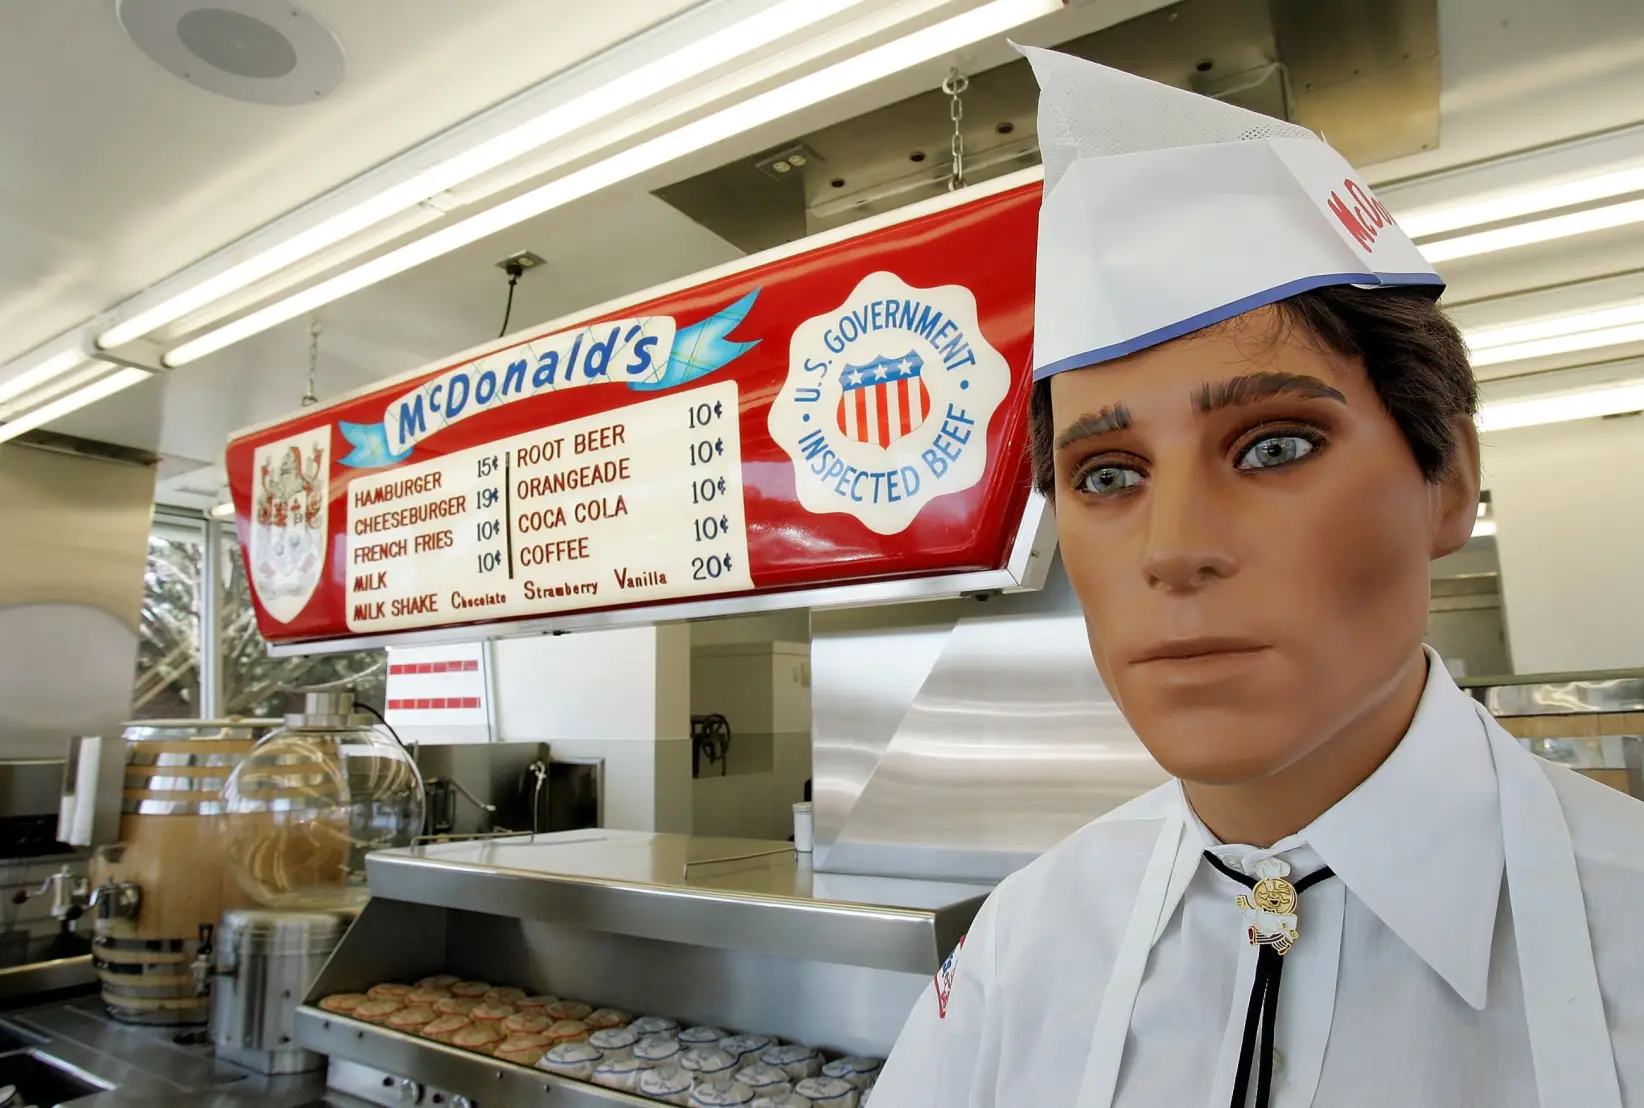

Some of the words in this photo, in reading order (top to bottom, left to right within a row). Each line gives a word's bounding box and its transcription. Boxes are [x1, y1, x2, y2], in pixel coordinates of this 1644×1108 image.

[1327, 178, 1398, 253] McDo
[794, 358, 832, 403] U.S.
[823, 299, 976, 372] GOVERNMENT
[399, 324, 659, 444] McDonald's
[517, 438, 565, 468] ROOT
[574, 424, 625, 455] BEER
[688, 400, 723, 428] 10¢
[798, 428, 921, 504] INSPECTED
[921, 402, 976, 480] BEEF
[355, 471, 442, 508] HAMBURGER
[477, 455, 499, 478] 15¢
[517, 457, 631, 500] ORANGEADE
[689, 437, 724, 466] 10¢
[354, 495, 466, 536] CHEESEBURGER
[476, 487, 499, 510] 19¢
[518, 506, 567, 533] COCA
[574, 494, 628, 523] COLA
[691, 476, 726, 504] 10¢
[353, 571, 387, 593] MILK
[477, 550, 501, 573] 10¢
[354, 538, 408, 565] FRENCH
[414, 529, 453, 554] FRIES
[476, 520, 500, 542] 10¢
[520, 537, 590, 567] COFFEE
[694, 514, 729, 542] 10¢
[353, 601, 386, 621] MILK
[391, 593, 439, 617] SHAKE
[451, 591, 507, 609] Chocolate
[614, 567, 667, 589] Vanilla
[691, 553, 733, 581] 20¢
